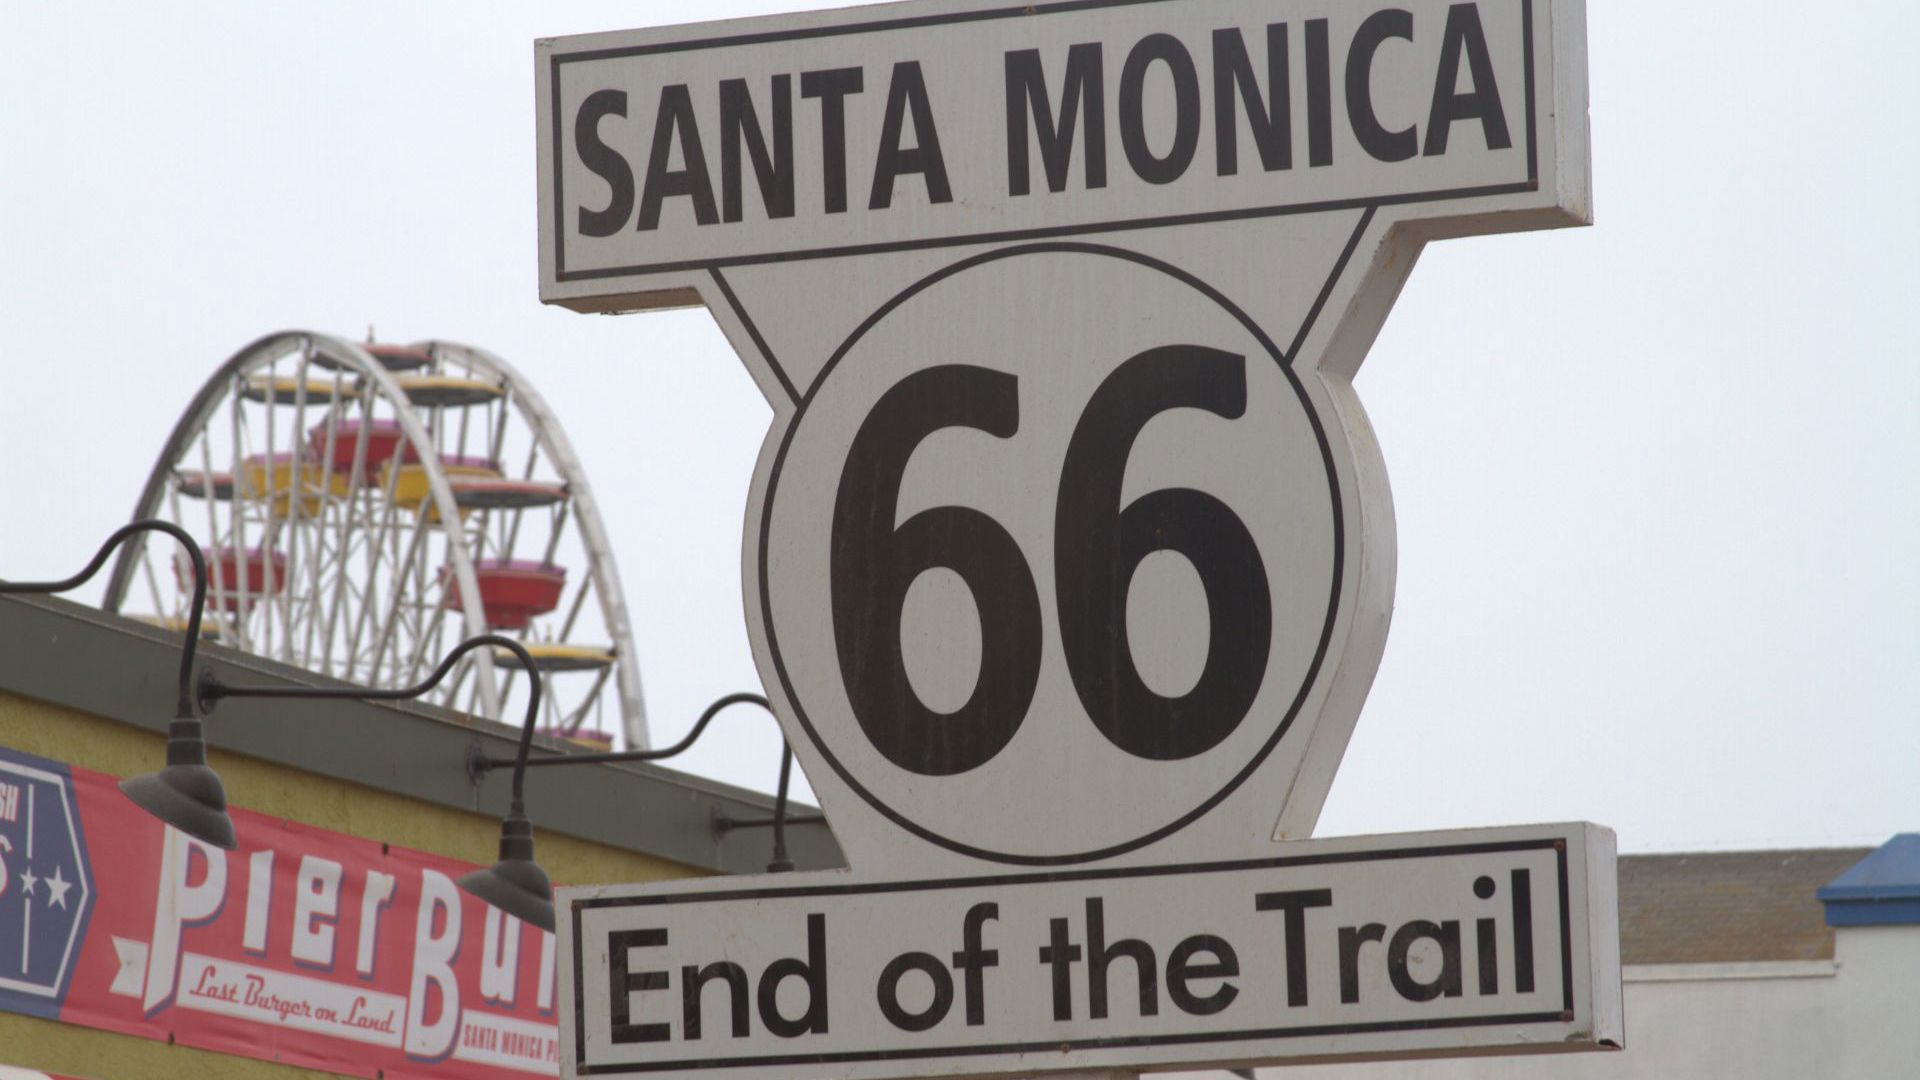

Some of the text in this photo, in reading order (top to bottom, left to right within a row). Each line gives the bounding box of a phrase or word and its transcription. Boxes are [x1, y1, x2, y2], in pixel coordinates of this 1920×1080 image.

[574, 2, 1513, 238] SANTA MONICA
[830, 344, 1273, 777] 66
[189, 965, 396, 1035] Last Burger on Land
[463, 1023, 498, 1053] SANTA
[501, 1030, 543, 1061] MONICA
[608, 868, 1535, 1044] End of the Trail
